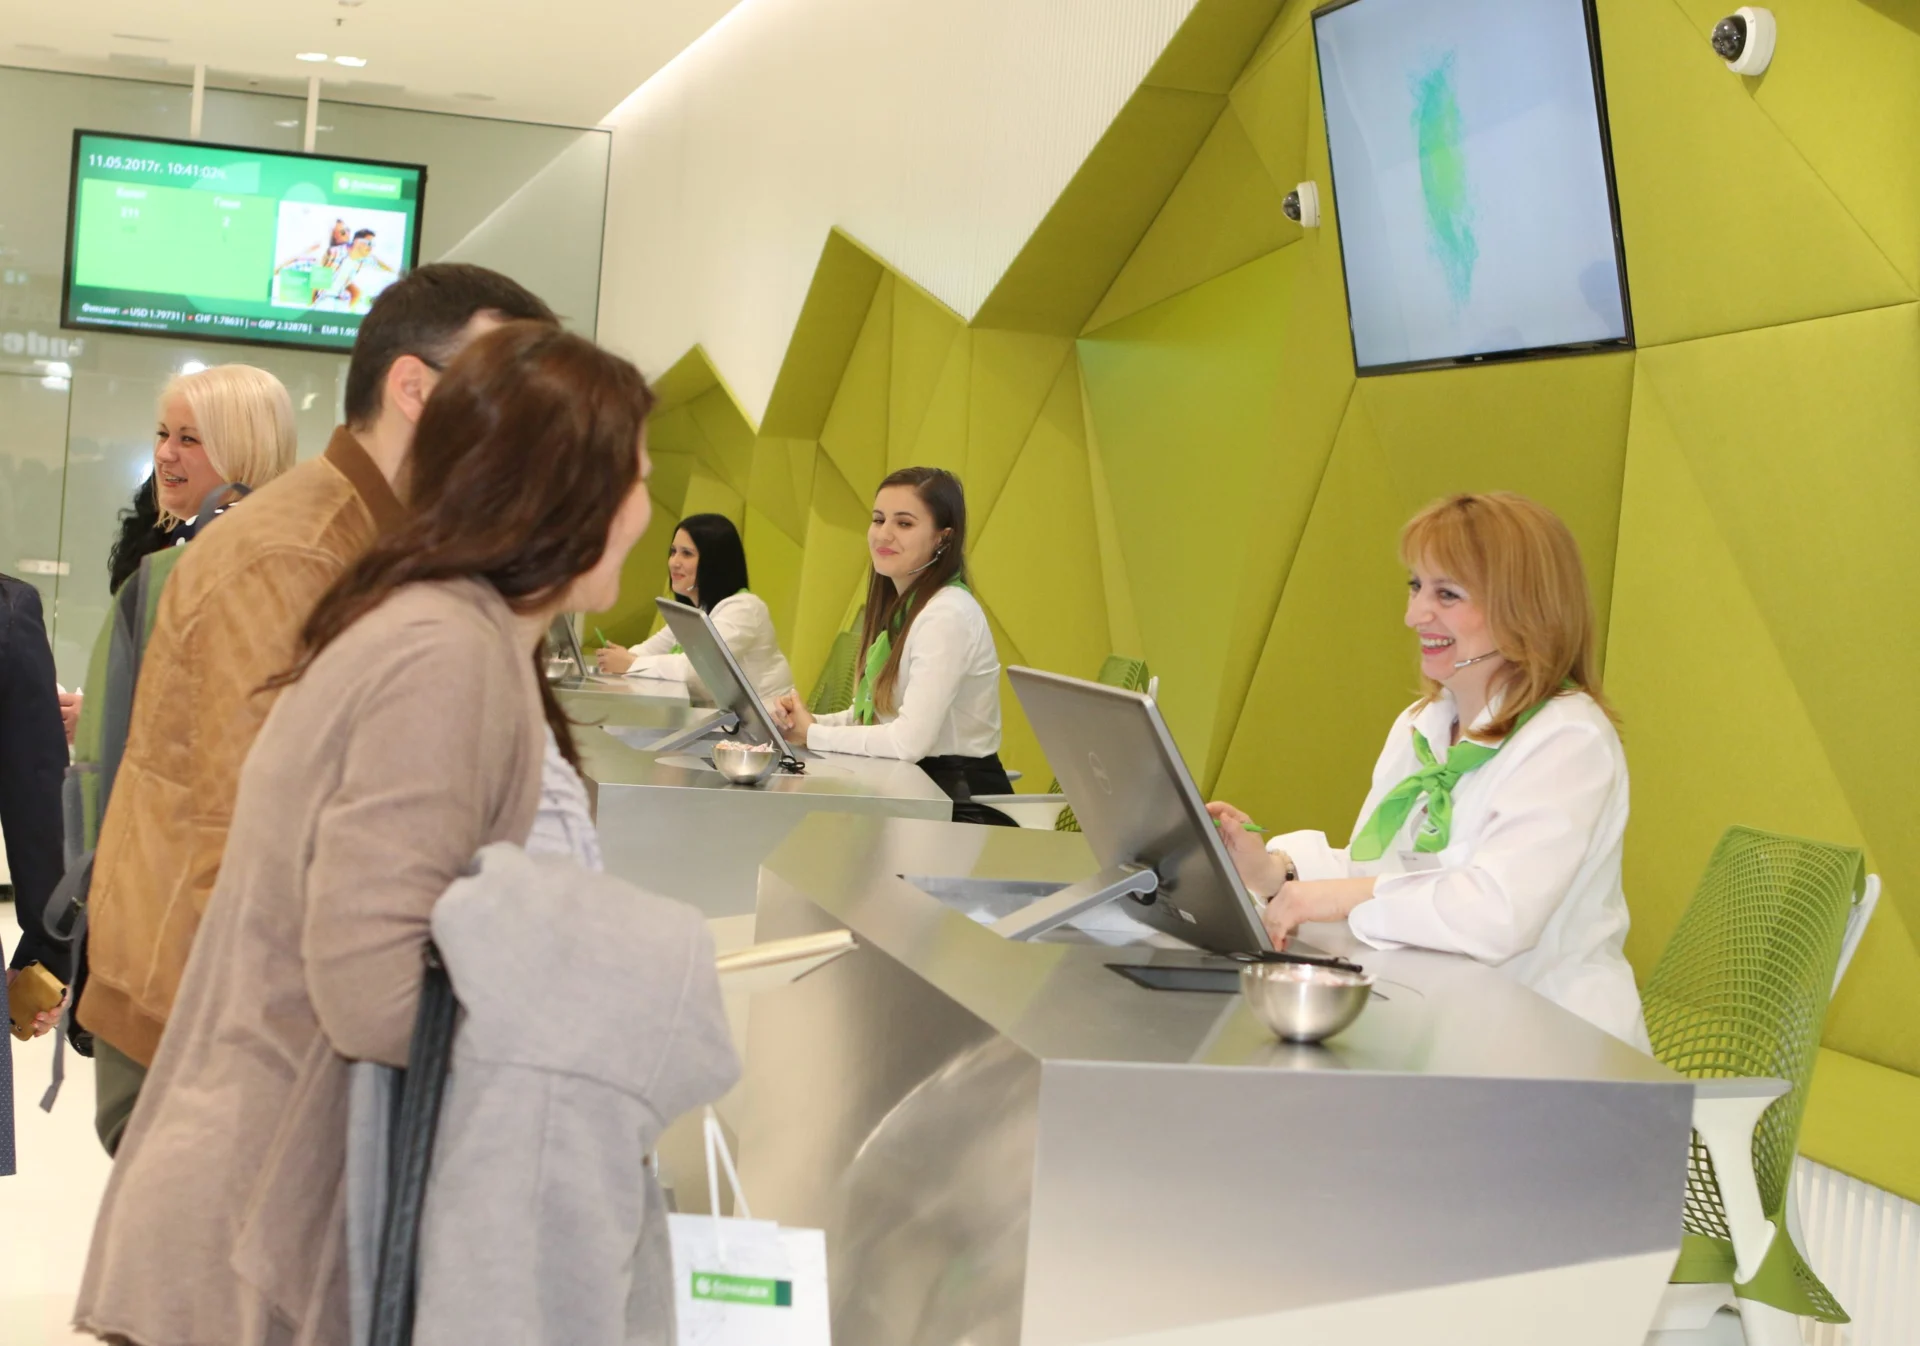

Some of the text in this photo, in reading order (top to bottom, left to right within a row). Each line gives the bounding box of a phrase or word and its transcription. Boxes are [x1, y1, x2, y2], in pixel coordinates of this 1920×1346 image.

[130, 307, 148, 318] USD
[195, 313, 213, 324] CHF
[258, 319, 276, 330] GBP
[321, 325, 339, 335] EUR
